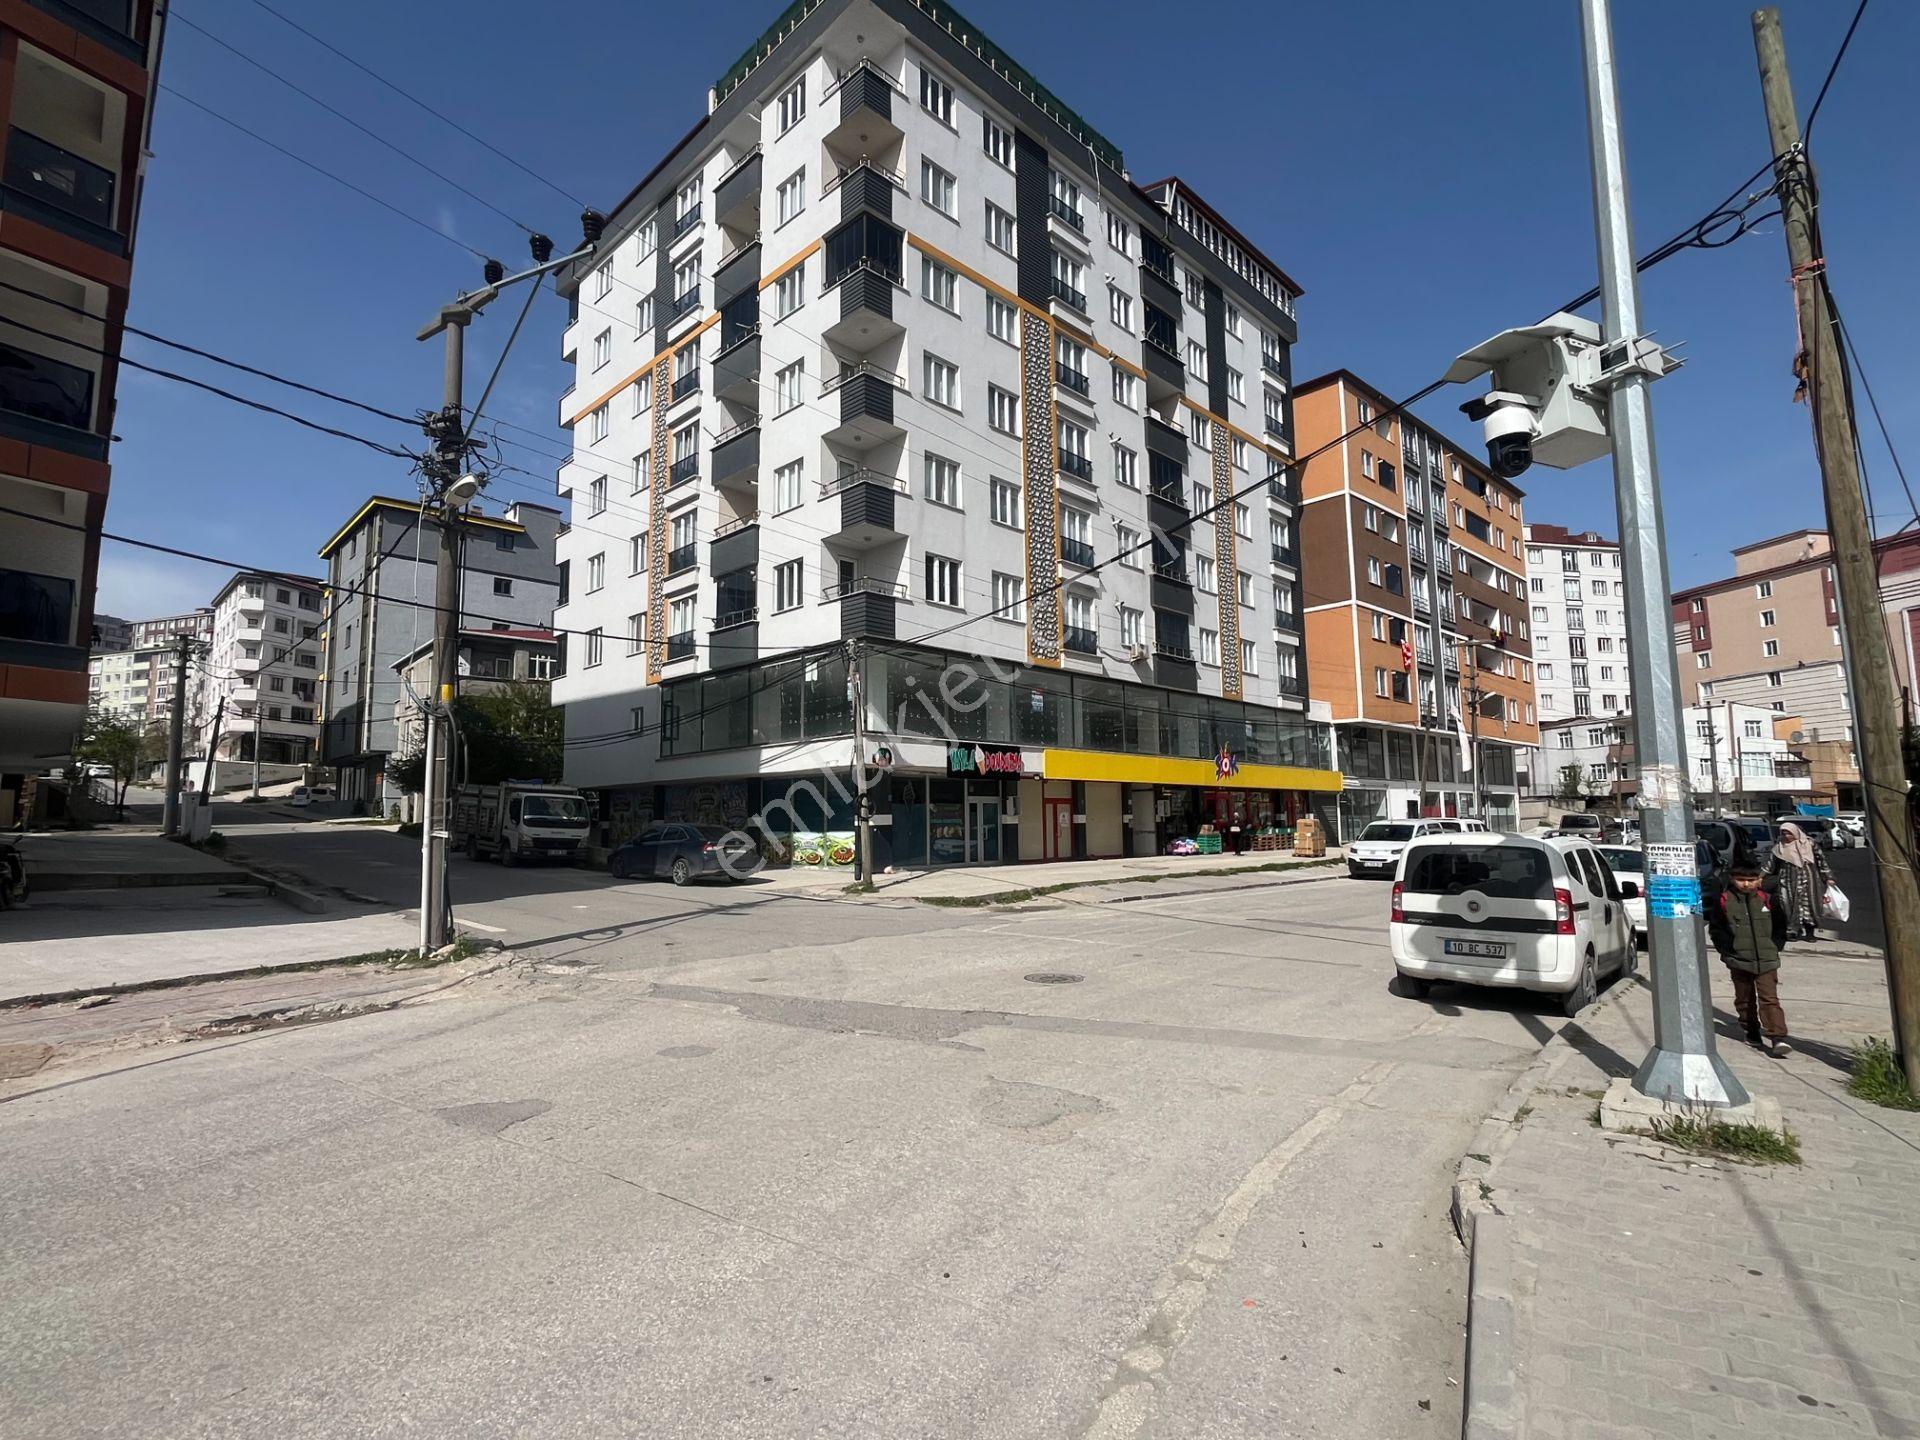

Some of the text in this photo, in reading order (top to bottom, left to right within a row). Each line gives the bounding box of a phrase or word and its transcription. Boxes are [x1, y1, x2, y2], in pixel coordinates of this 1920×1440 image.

[1453, 943, 1503, 955] 10 BC 537
